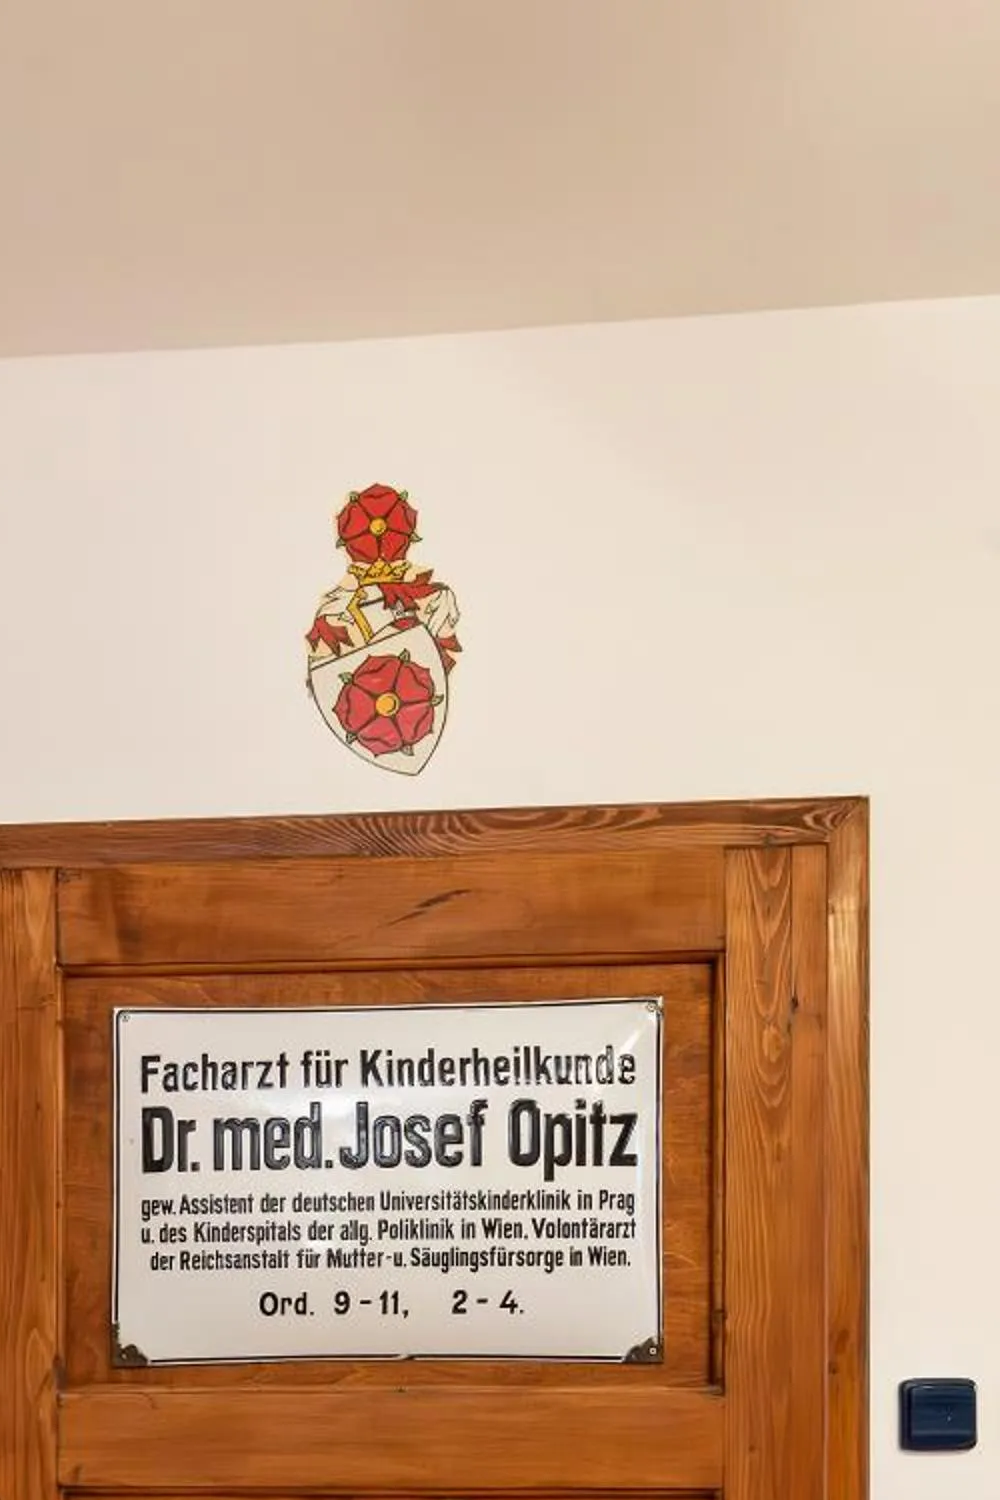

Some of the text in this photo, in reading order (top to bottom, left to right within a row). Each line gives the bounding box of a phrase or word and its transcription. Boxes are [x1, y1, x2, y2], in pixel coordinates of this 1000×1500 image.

[141, 1044, 637, 1094] Facharzt für Kinderheilkunde
[142, 1098, 638, 1182] Dr. med. Josef Opitz
[141, 1190, 636, 1221] gew. Assistent der deutschen Universitätskinderklinik in Prag
[141, 1216, 636, 1246] u. des Kinderspitals der allg. Poliklinik in Wien. Volontärarzt
[151, 1251, 175, 1270] der
[179, 1249, 290, 1271] Reichsanstalt
[296, 1248, 321, 1268] für
[410, 1246, 564, 1274] Säuglingsfürsorge
[569, 1246, 583, 1267] in
[587, 1246, 632, 1267] Wien.
[259, 1290, 315, 1316] Ord.
